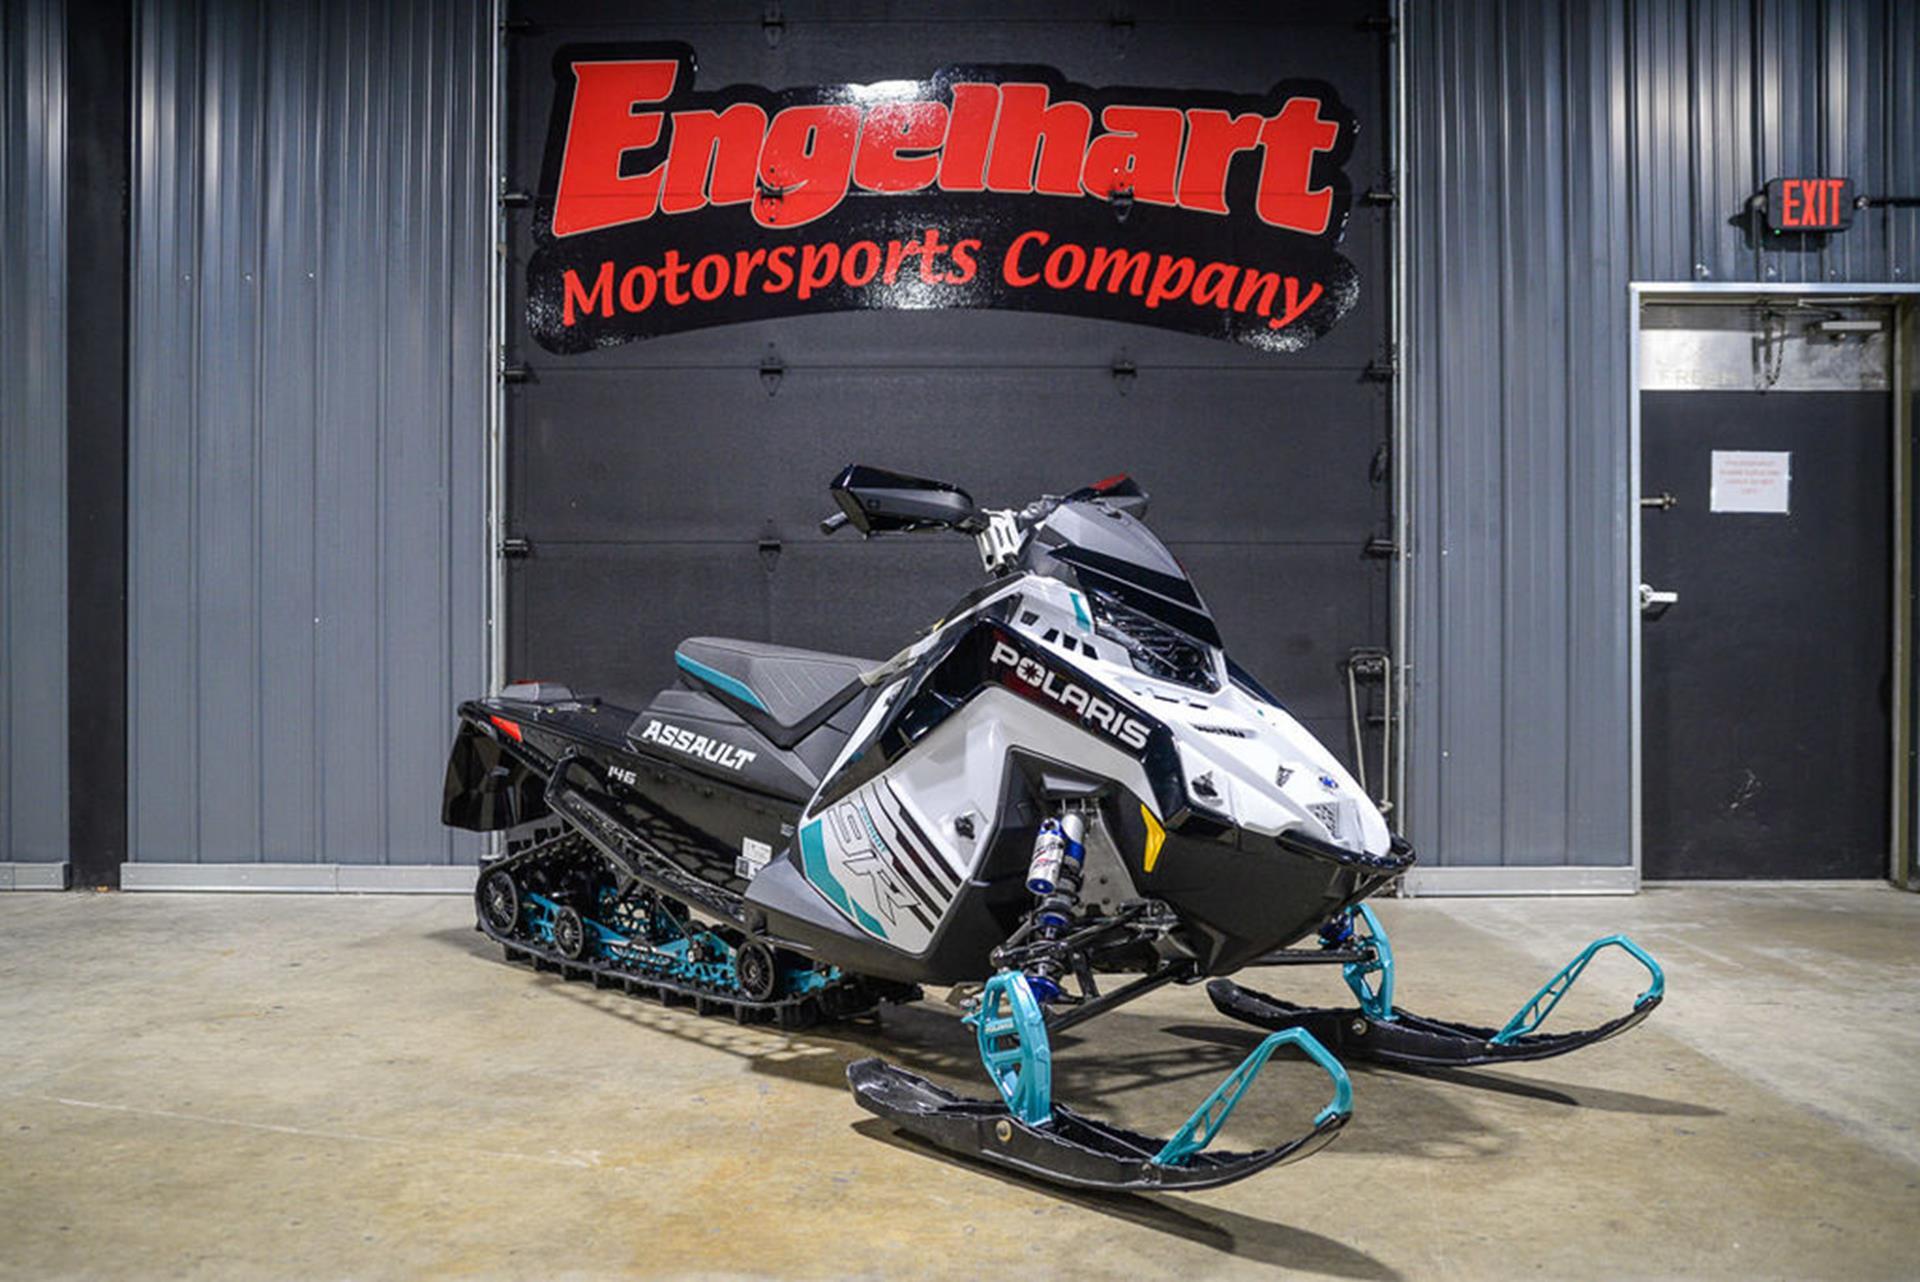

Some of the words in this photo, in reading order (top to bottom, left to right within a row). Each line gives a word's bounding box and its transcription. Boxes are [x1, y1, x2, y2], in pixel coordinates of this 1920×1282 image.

[552, 59, 1341, 237] Engelhart
[1782, 179, 1844, 227] EXIT
[562, 229, 982, 327] Motorsports
[1003, 230, 1324, 331] Company
[989, 642, 1151, 752] POLARIS
[607, 765, 638, 785] 146
[641, 720, 757, 771] ASSAULT
